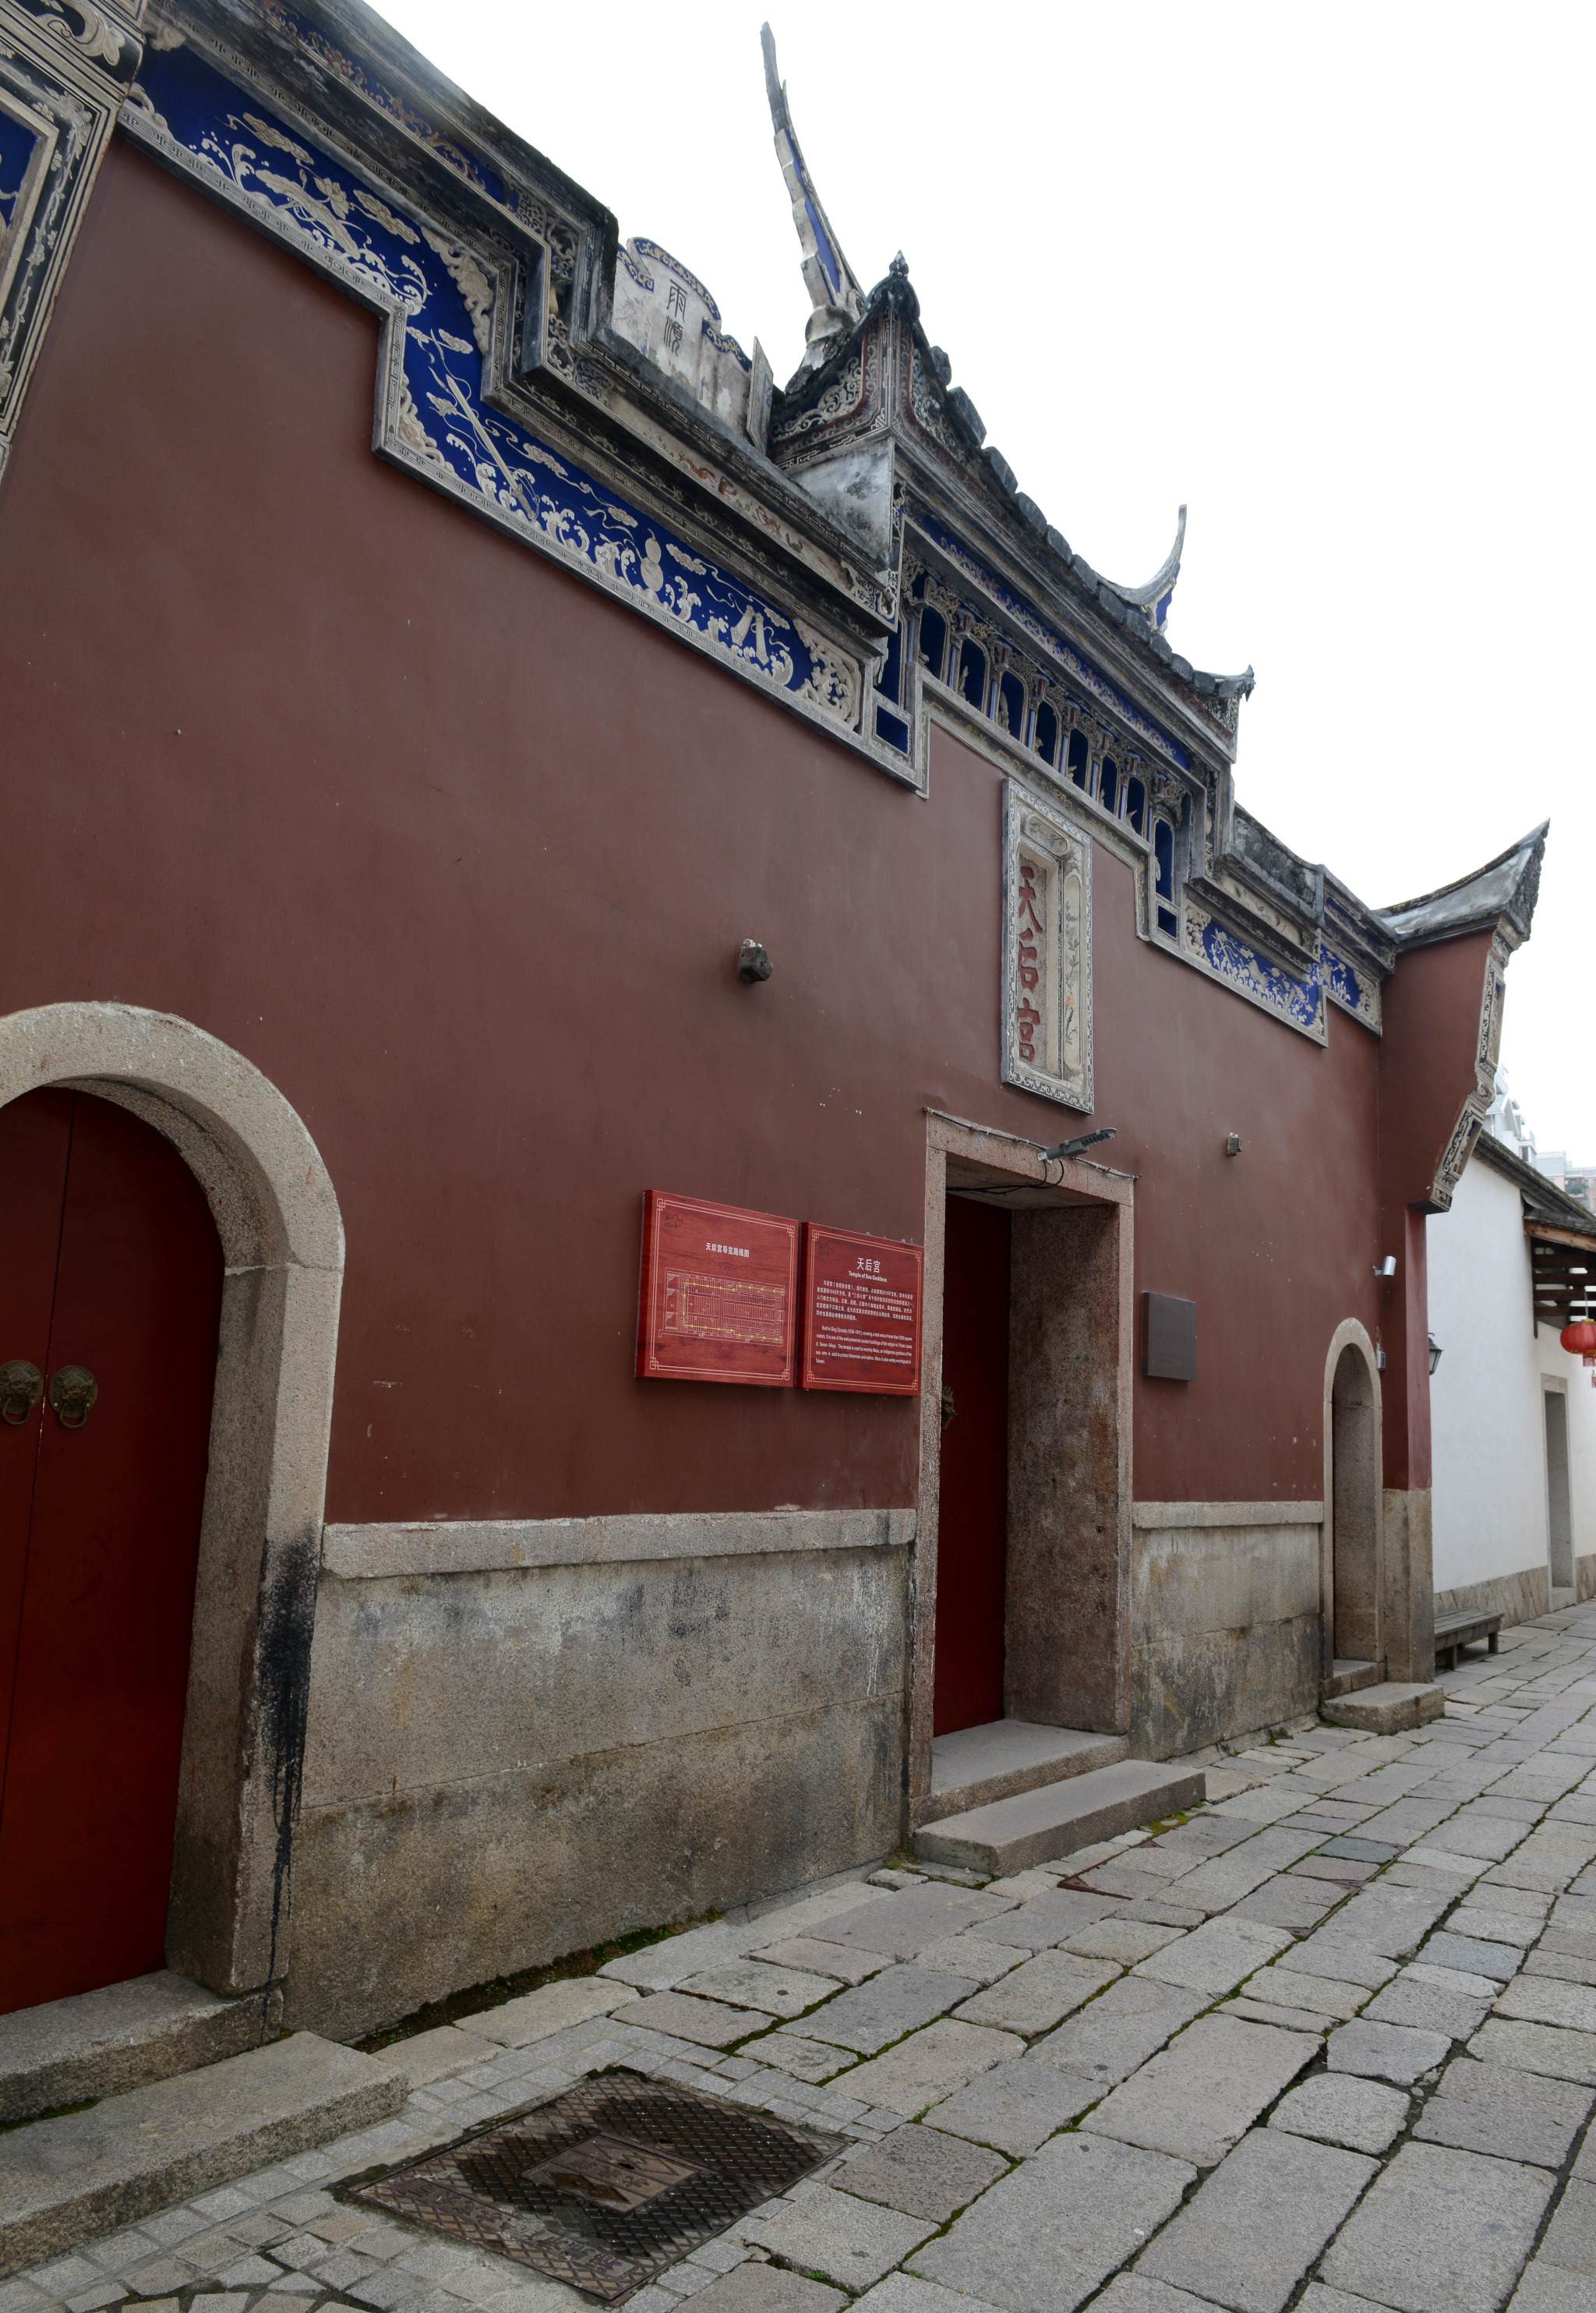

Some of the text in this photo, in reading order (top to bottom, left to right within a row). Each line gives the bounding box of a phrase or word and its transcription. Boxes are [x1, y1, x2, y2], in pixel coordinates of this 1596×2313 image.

[705, 1242, 750, 1258] 天后宫导览路线图
[856, 1257, 881, 1273] 天后宫
[872, 1274, 888, 1283] Goddess
